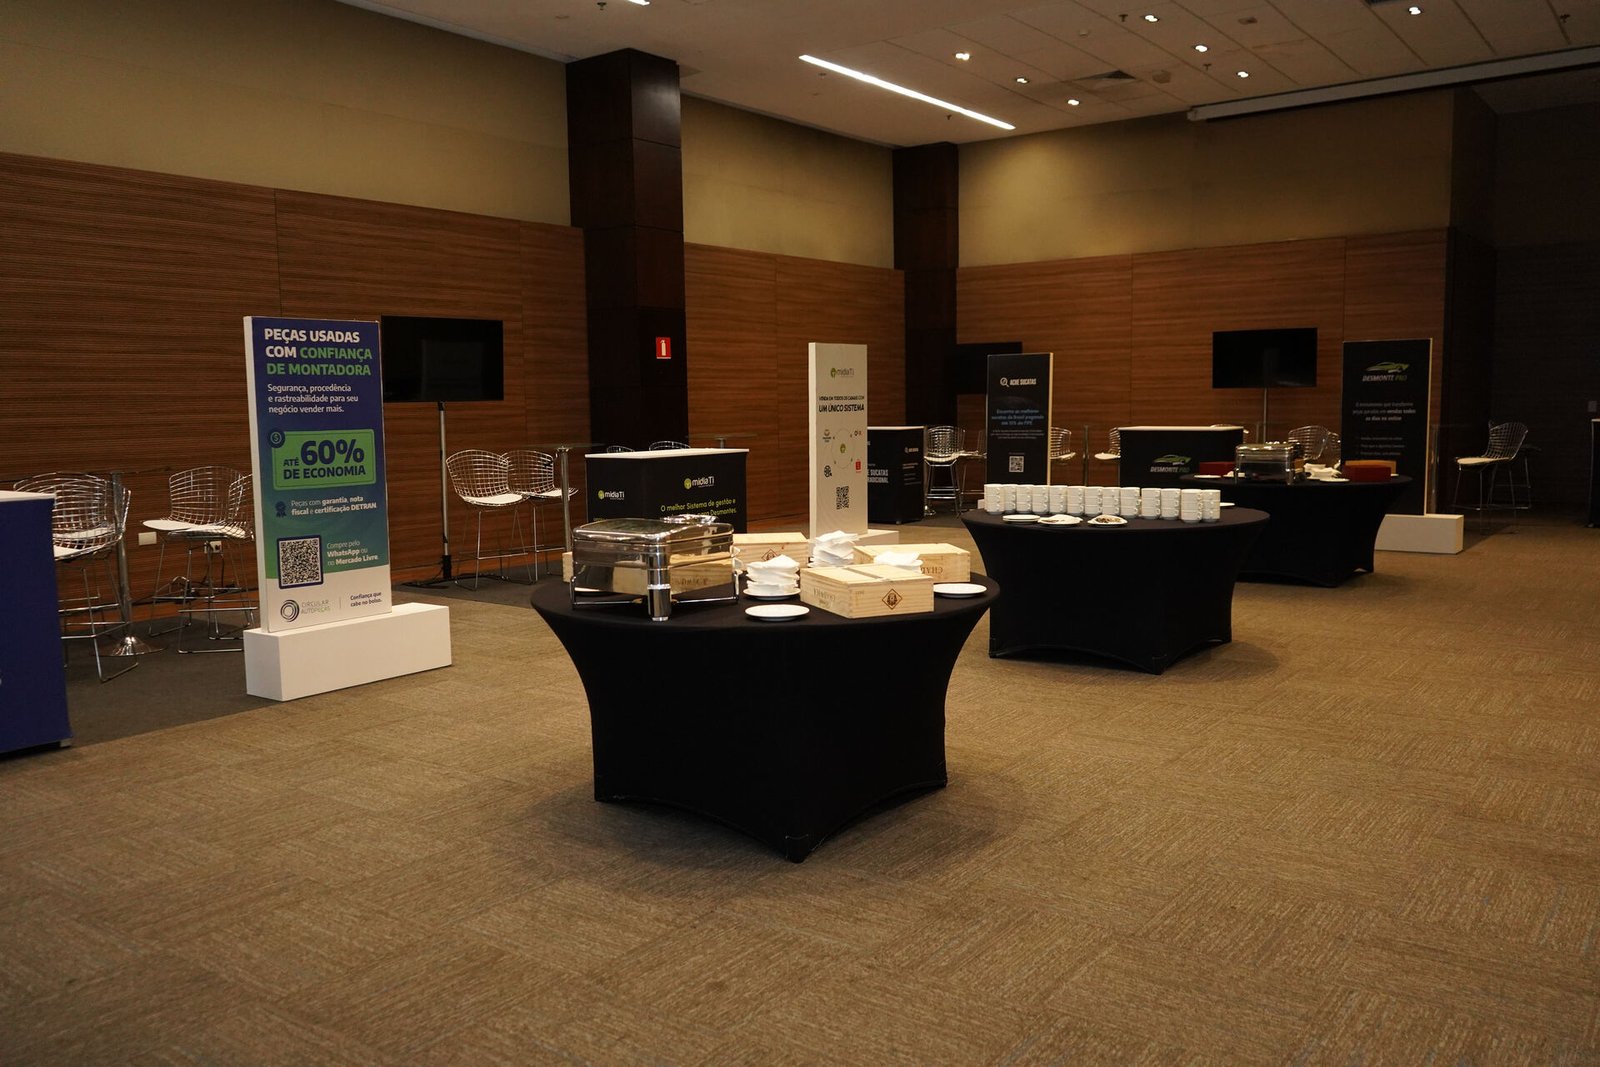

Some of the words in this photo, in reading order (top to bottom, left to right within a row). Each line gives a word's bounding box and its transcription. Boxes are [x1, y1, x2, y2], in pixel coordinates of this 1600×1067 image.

[264, 328, 307, 344] PEÇAS
[309, 330, 360, 343] USADAS
[265, 345, 297, 358] COM
[300, 347, 373, 362] CONFIANÇA
[266, 363, 286, 375] DE
[288, 364, 372, 376] MONTADORA
[1020, 378, 1037, 386] SUCATAS
[1362, 374, 1395, 382] DESMONTE
[267, 383, 308, 394] Segurança,
[309, 384, 352, 394] procedência
[274, 394, 329, 403] rastreabilidade
[329, 396, 345, 405] para
[268, 405, 299, 416] negócio
[299, 406, 325, 414] vender
[325, 406, 344, 414] mais.
[818, 404, 828, 412] UM
[844, 403, 865, 412] SISTEMA
[301, 439, 365, 465] 60%
[283, 457, 299, 467] ATÉ
[283, 469, 300, 479] DE
[303, 465, 366, 478] ECONOMIA
[291, 507, 309, 516] fiscal
[314, 505, 350, 514] certificação
[686, 502, 707, 510] Sistema
[348, 540, 361, 548] pelo
[327, 549, 360, 558] WhatsApp
[335, 556, 362, 565] Mercado
[350, 594, 372, 602] Confiança
